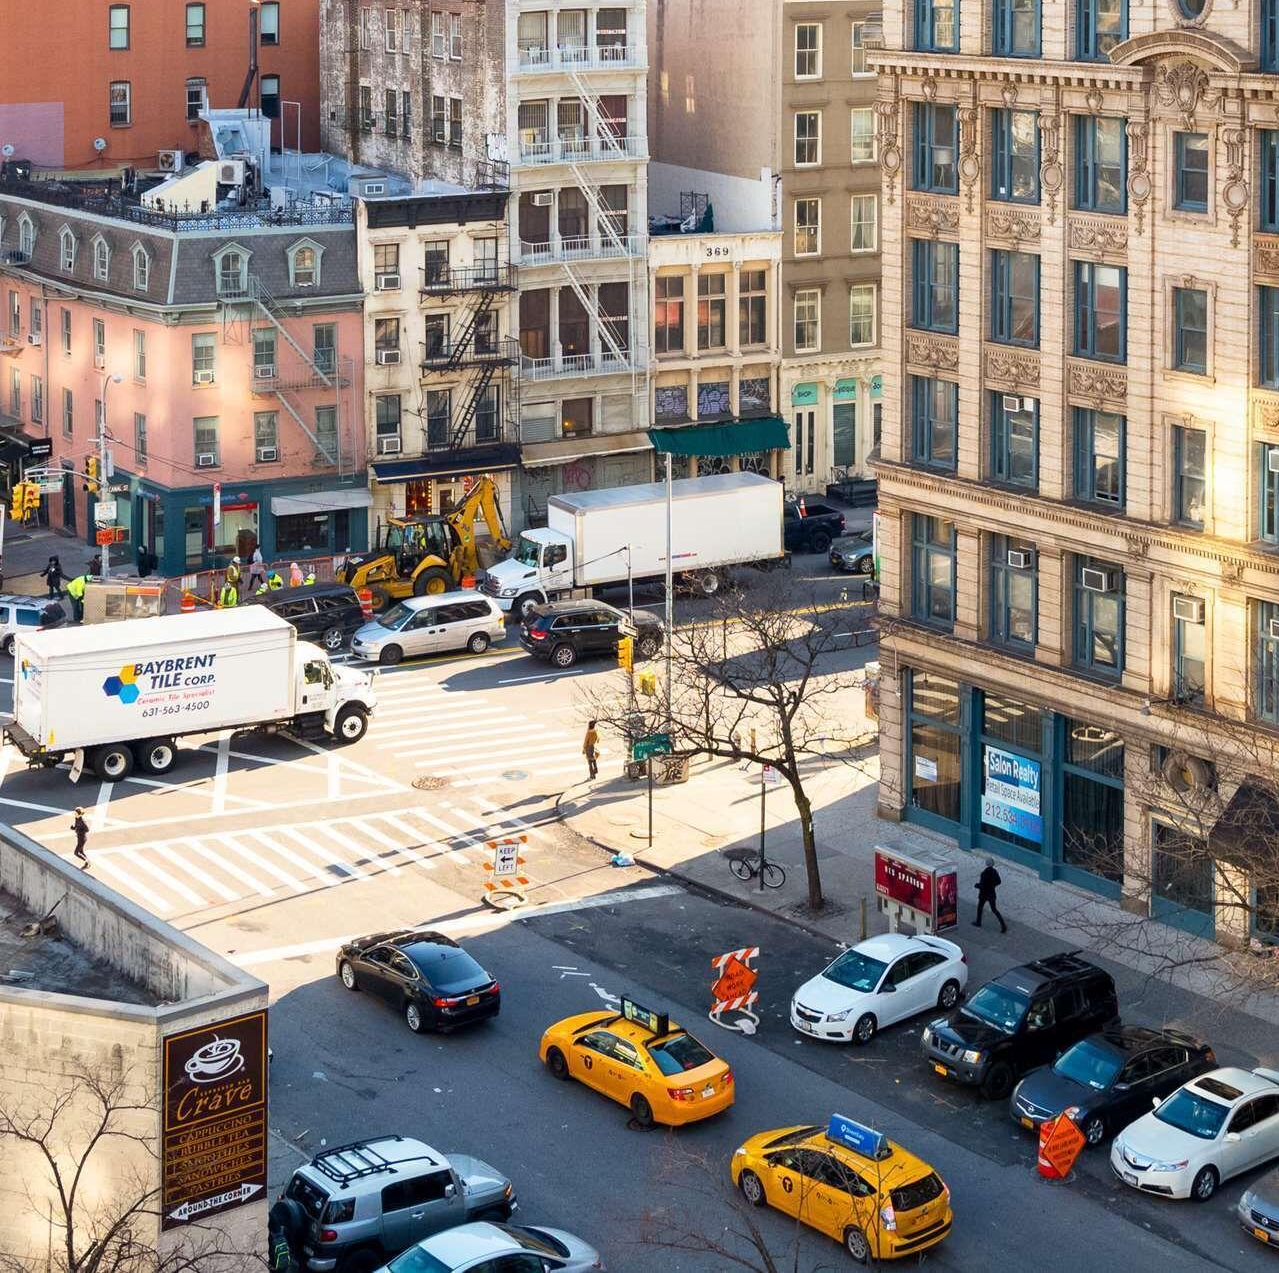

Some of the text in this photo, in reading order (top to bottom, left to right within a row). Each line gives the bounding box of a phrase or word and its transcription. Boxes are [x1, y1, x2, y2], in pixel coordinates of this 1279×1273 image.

[133, 654, 216, 676] BAYBRENT
[151, 672, 216, 689] TILE CORP.
[142, 700, 210, 717] 631-563-4500
[990, 753, 1039, 789] Salon Realty
[1001, 784, 1016, 800] Space
[1017, 790, 1040, 809] Available
[499, 847, 516, 855] KEEP
[727, 970, 744, 980] ROAD
[177, 1084, 252, 1121] Crave
[180, 1115, 252, 1144] CAPPUCCINO
[181, 1129, 249, 1156] BUBBLE TEA
[178, 1155, 253, 1184] SANDWICHES
[190, 1173, 242, 1193] PASTRIES
[178, 1186, 251, 1216] AROUND THE CORNER
